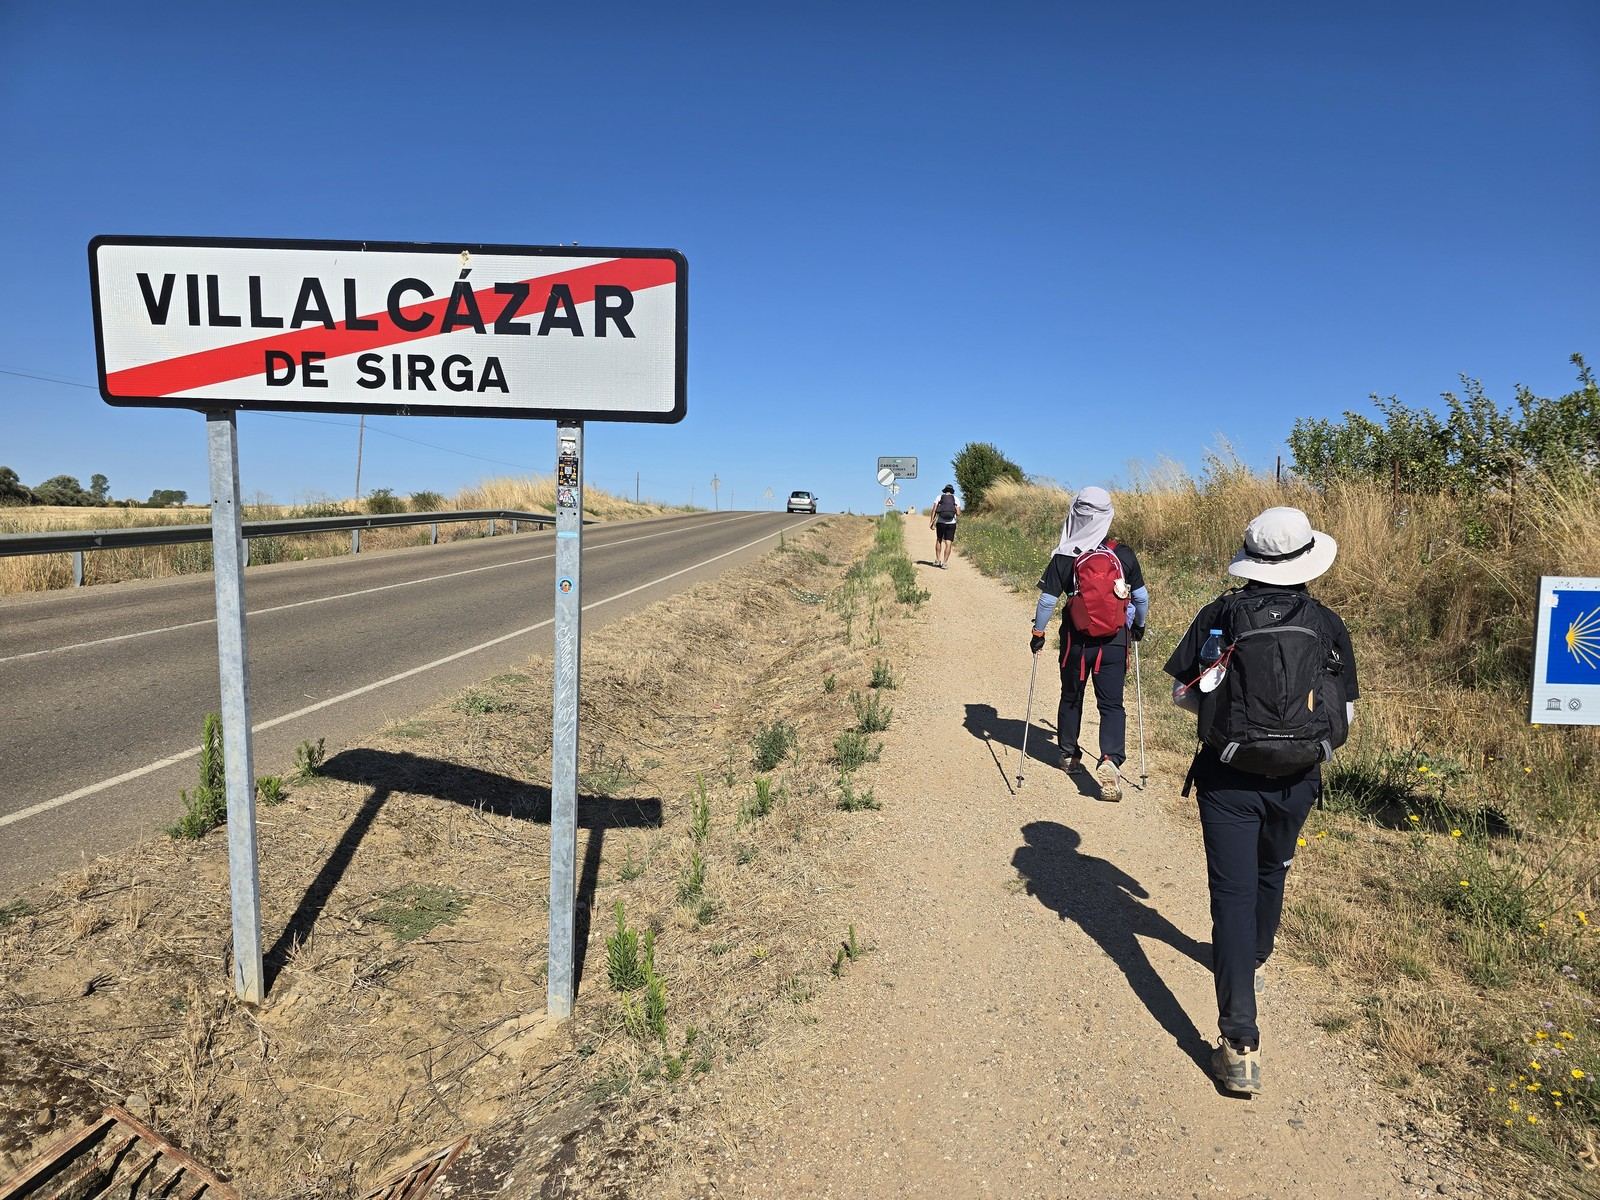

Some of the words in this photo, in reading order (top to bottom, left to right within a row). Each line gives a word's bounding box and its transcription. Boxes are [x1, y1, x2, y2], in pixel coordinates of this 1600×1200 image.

[136, 268, 636, 339] VILLALCÁZAR
[265, 350, 329, 388] DE
[356, 352, 510, 394] SIRGA
